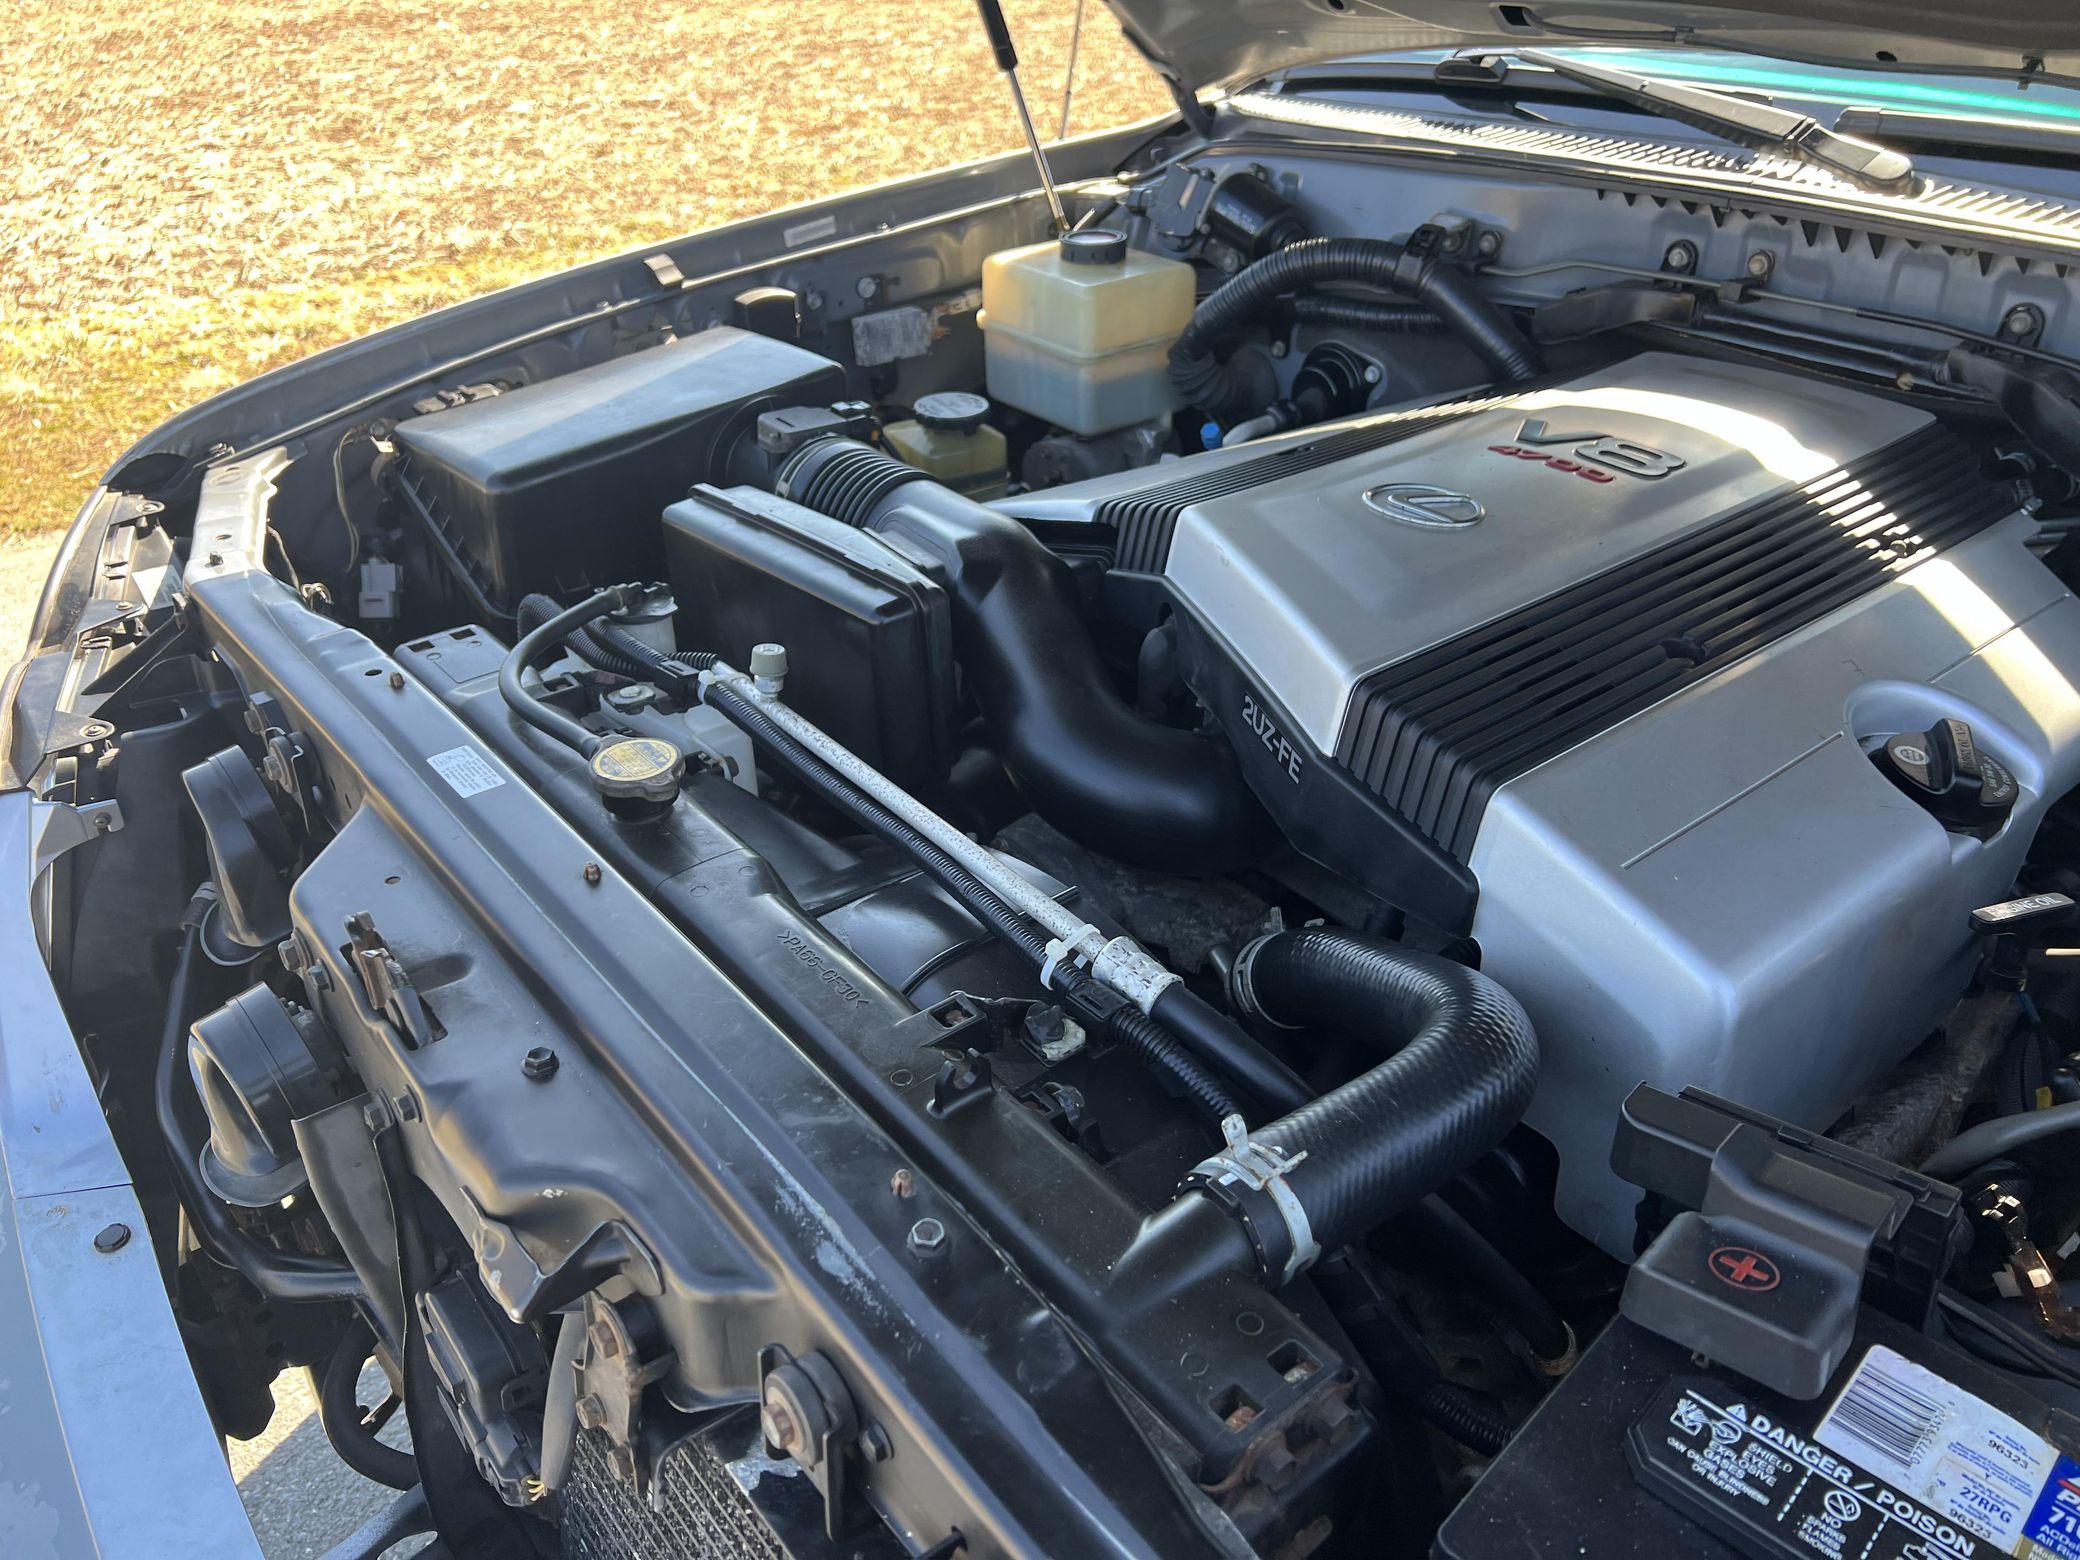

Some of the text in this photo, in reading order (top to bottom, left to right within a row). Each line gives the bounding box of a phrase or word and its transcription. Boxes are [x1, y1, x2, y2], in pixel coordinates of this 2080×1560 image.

[1513, 418, 1688, 480] V8
[1241, 695, 1303, 785] 2UZ-FE
[2035, 896, 2063, 906] OIL
[1703, 1448, 1746, 1479] GASES
[1708, 1440, 1777, 1487] EXPLOSIVE
[1742, 1450, 1776, 1475] EYES
[1748, 1441, 1793, 1473] SHIELD
[1987, 1439, 2029, 1470] 96323
[1751, 1414, 1854, 1484] DANGER
[1876, 1489, 1976, 1557] POISON
[1821, 1512, 1842, 1529] NO
[1959, 1486, 2013, 1523] 27RPG
[1949, 1508, 1992, 1539] 96323
[2048, 1505, 2080, 1540] 71
